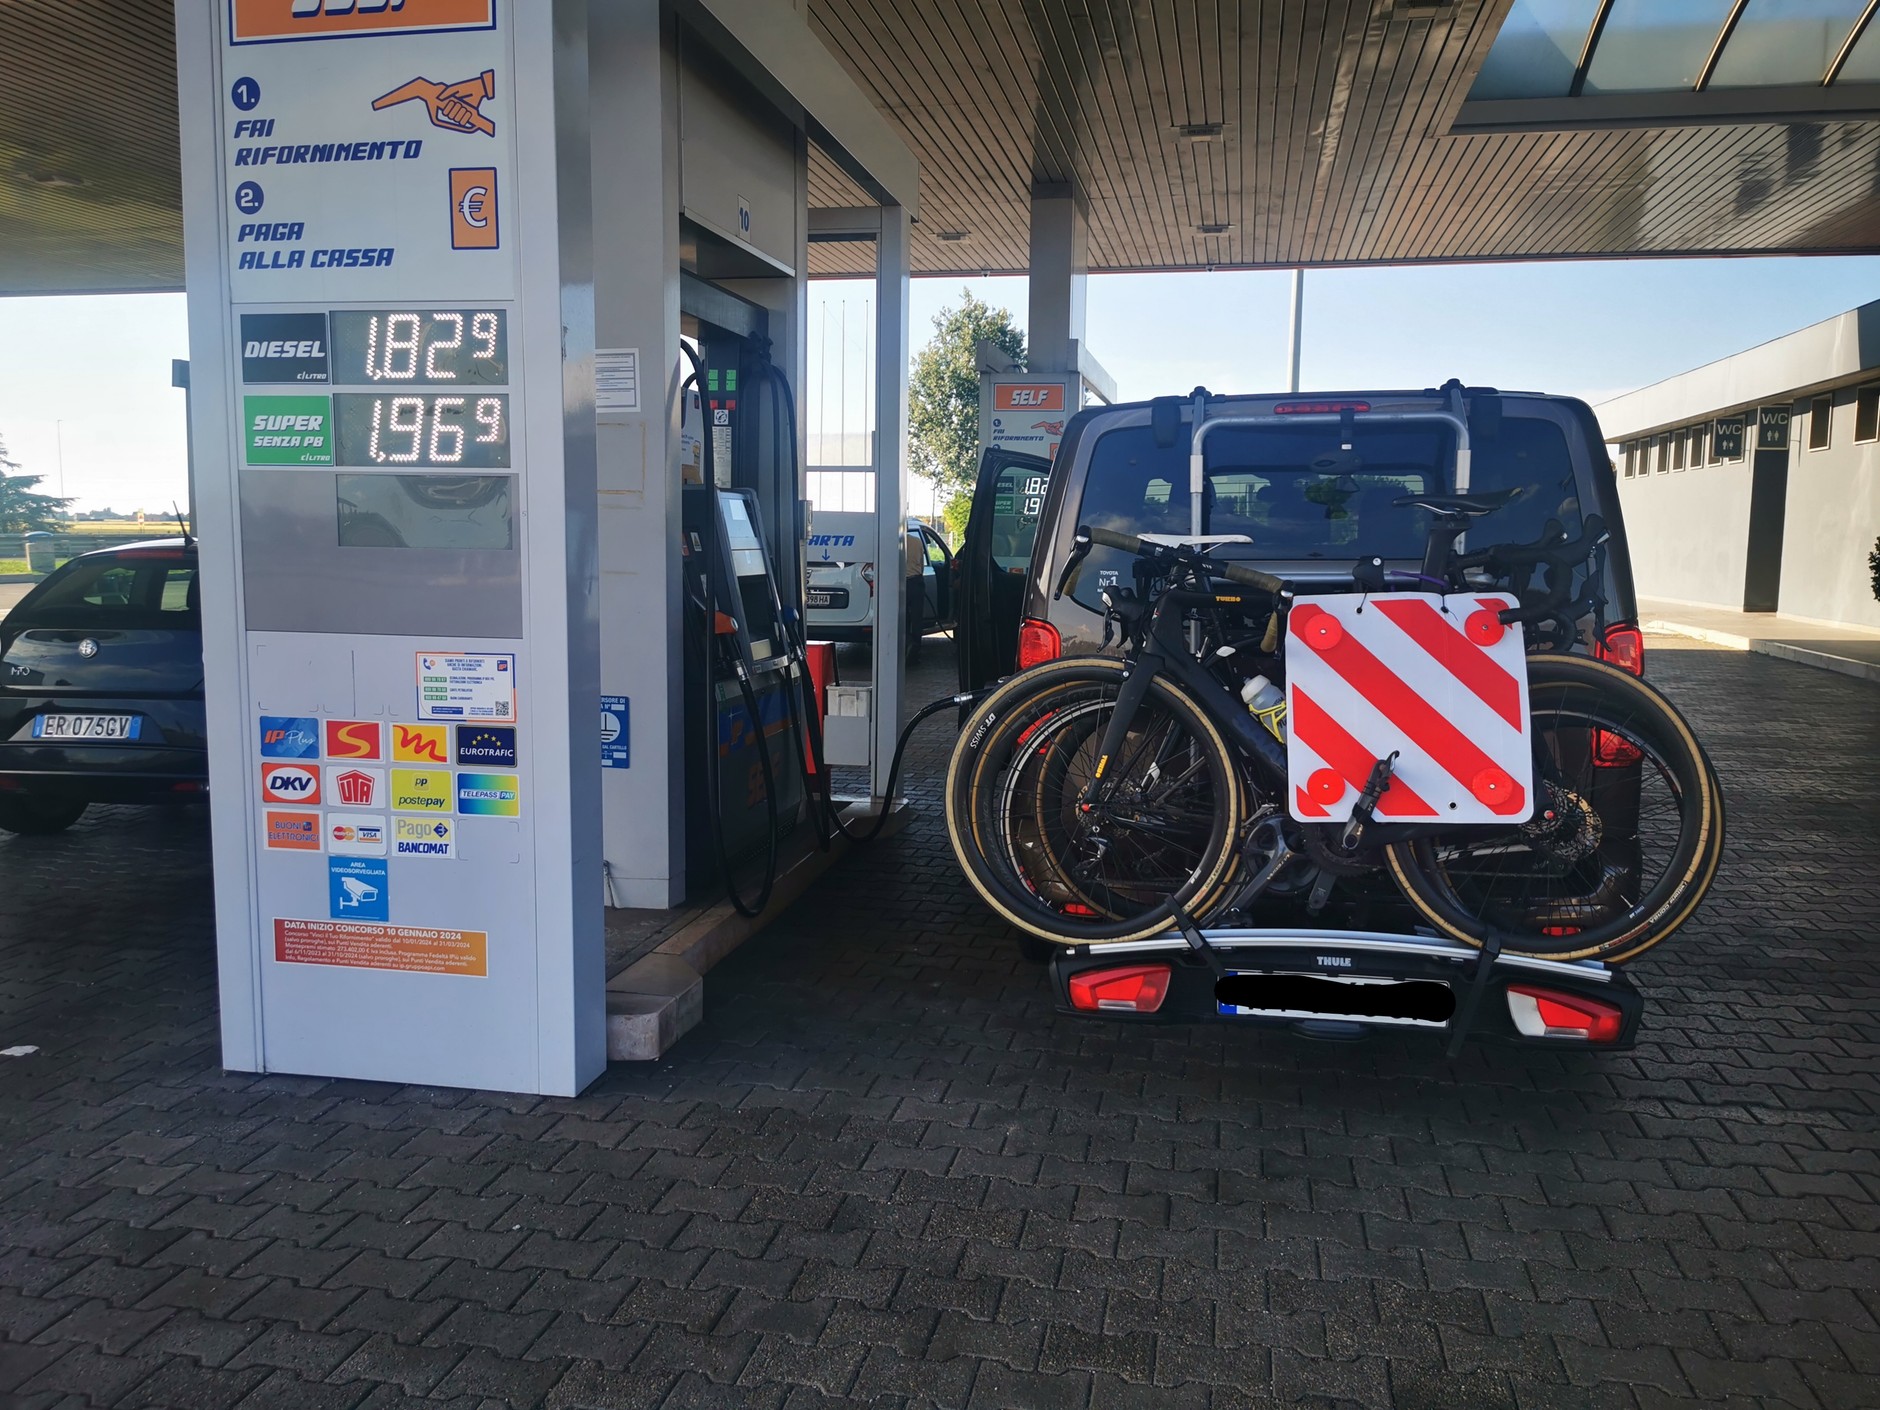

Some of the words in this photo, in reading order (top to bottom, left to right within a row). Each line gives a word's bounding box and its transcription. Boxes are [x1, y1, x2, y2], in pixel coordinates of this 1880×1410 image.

[234, 119, 275, 138] FAI
[235, 140, 422, 166] RIFORNIMENTO
[738, 207, 750, 232] 10
[238, 222, 305, 242] PAGA
[239, 250, 305, 270] ALLA
[310, 248, 395, 268] CASSA
[244, 340, 326, 358] DIESEL
[1011, 390, 1048, 406] SELF
[253, 415, 324, 431] SUPER
[1761, 413, 1788, 425] WC
[1717, 424, 1742, 435] WC
[253, 436, 302, 447] SENZA
[303, 436, 324, 447] PB
[45, 716, 67, 736] ER
[72, 716, 130, 736] 075GV
[264, 730, 285, 744] IP
[286, 730, 315, 745] Plus
[459, 747, 514, 757] EUROTRAFIC
[269, 775, 312, 792] DKV
[337, 770, 376, 804] UTA
[398, 795, 446, 808] postepay
[462, 789, 498, 799] TELEPASS
[499, 791, 515, 800] PAY
[275, 820, 302, 830] BUONI
[397, 819, 432, 838] Pago
[268, 831, 320, 842] ELETTRONICI
[398, 841, 449, 854] BANCOMAT
[331, 867, 386, 876] VIDEOSORVEGLIATA
[284, 921, 306, 929] DATA
[308, 923, 334, 931] INIZIO
[336, 925, 385, 935] CONCORSO
[398, 929, 438, 938] GENNAIO
[440, 932, 462, 940] 2024
[1316, 956, 1352, 967] THULE
